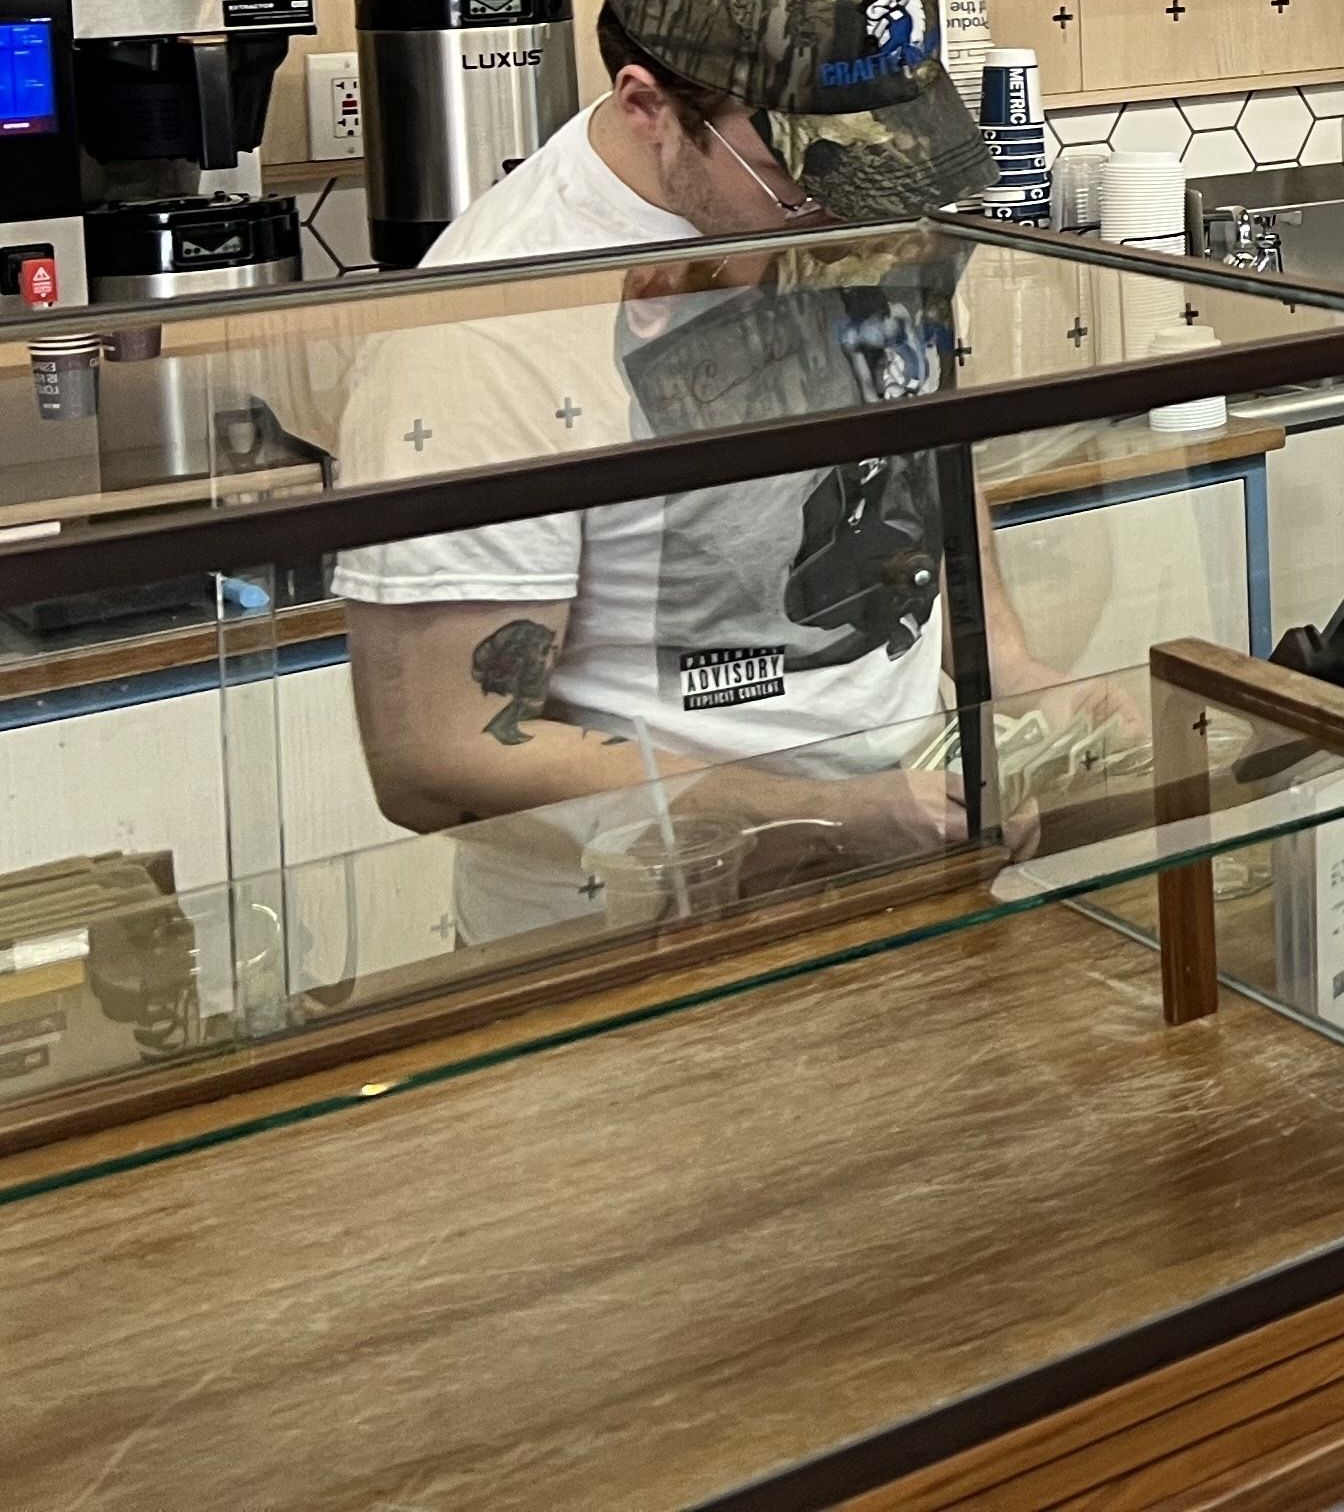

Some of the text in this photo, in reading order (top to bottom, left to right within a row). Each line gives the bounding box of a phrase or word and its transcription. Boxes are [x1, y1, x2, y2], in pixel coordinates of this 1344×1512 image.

[462, 49, 543, 70] LUXUS
[1008, 68, 1028, 124] METRIC
[687, 655, 781, 693] ADVISORY
